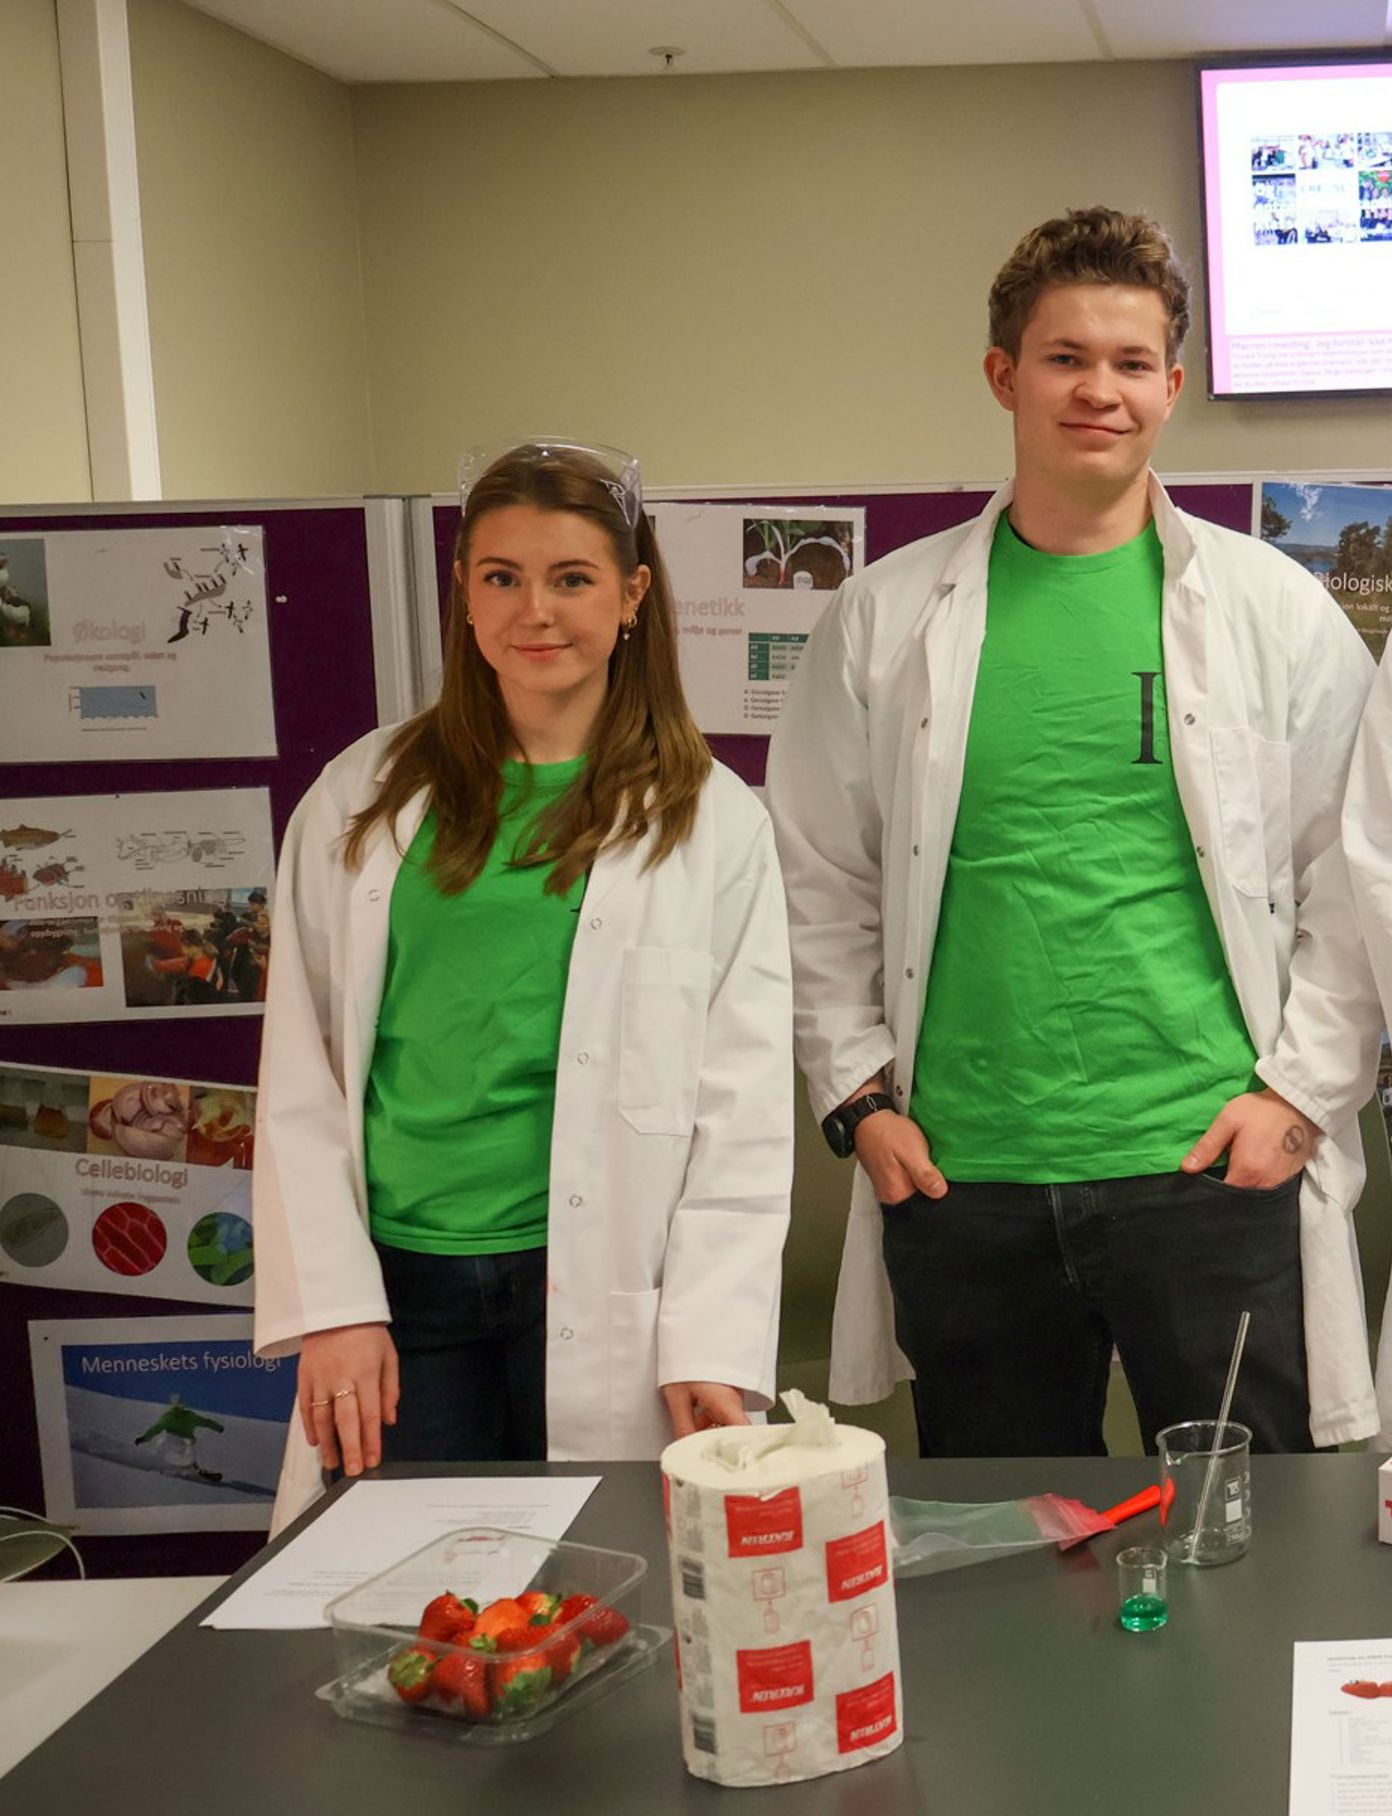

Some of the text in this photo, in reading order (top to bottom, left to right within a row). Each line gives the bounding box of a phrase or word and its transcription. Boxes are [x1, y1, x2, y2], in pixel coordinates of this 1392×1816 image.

[676, 597, 745, 616] enetikk
[73, 619, 146, 644] Økologi
[1131, 672, 1163, 765] I
[75, 1157, 189, 1190] Cellebiologi
[81, 1353, 198, 1374] Menneskets
